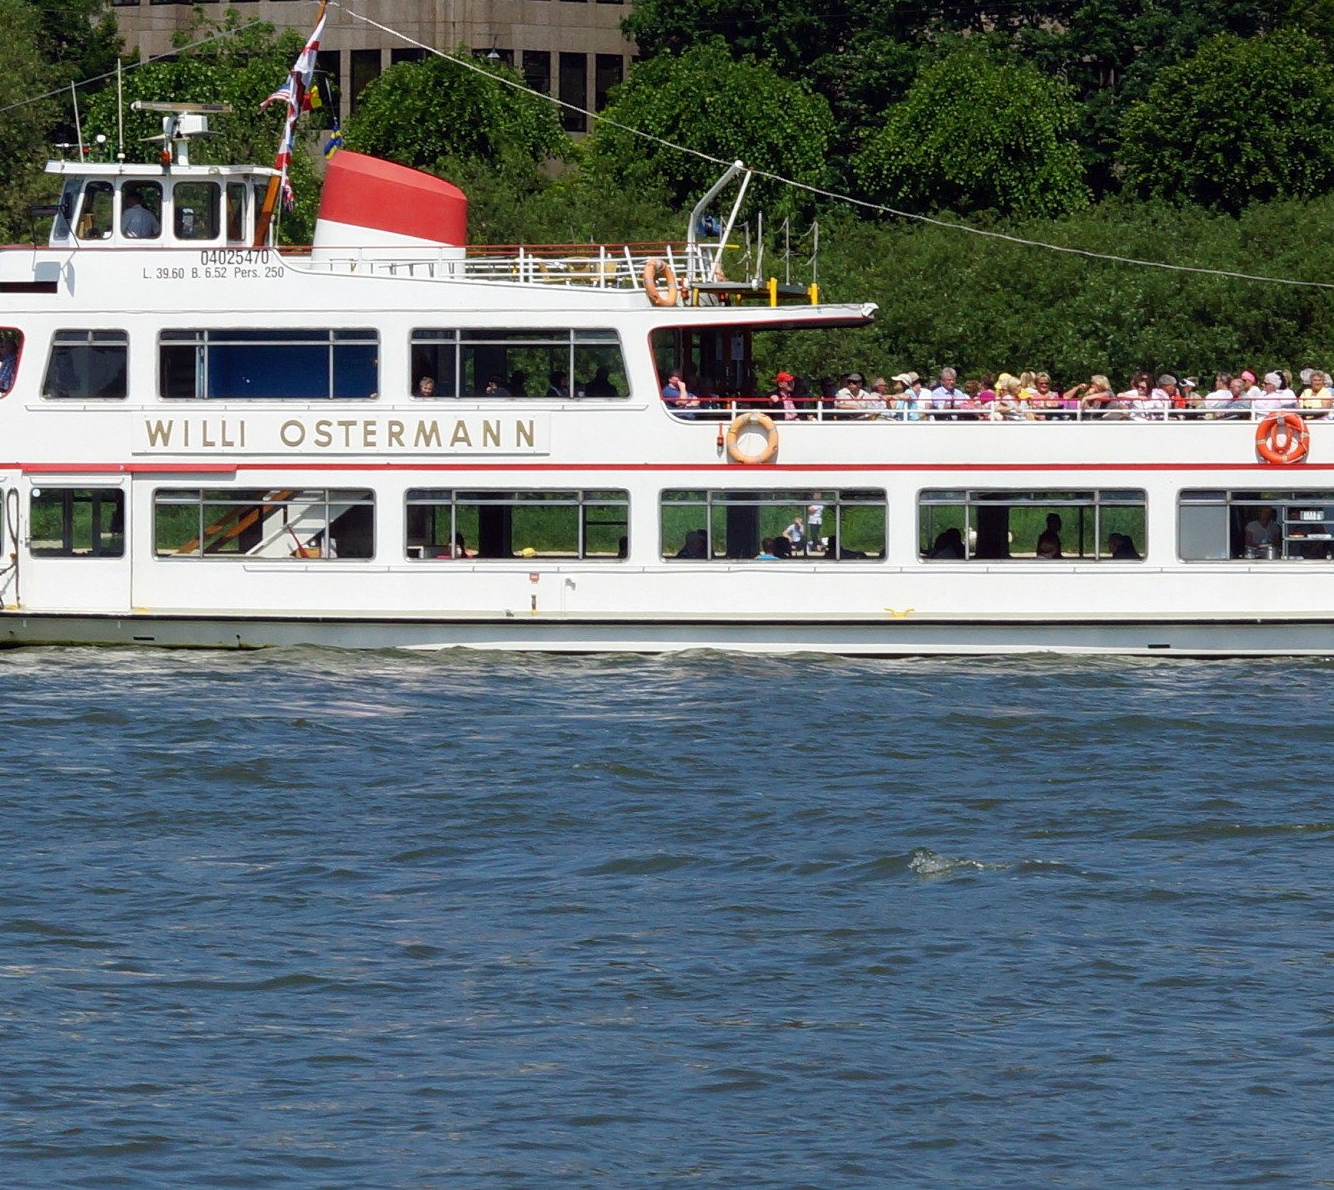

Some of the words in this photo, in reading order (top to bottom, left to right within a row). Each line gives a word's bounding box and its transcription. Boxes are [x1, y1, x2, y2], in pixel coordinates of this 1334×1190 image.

[200, 249, 269, 266] 04025470
[142, 267, 153, 279] L.
[156, 267, 185, 279] 39.60
[191, 267, 201, 279] B.
[204, 266, 228, 279] 6.52
[234, 266, 261, 278] Pers.
[264, 266, 285, 278] 250
[145, 419, 246, 447] WILLI
[279, 419, 536, 448] OSTERMANN
